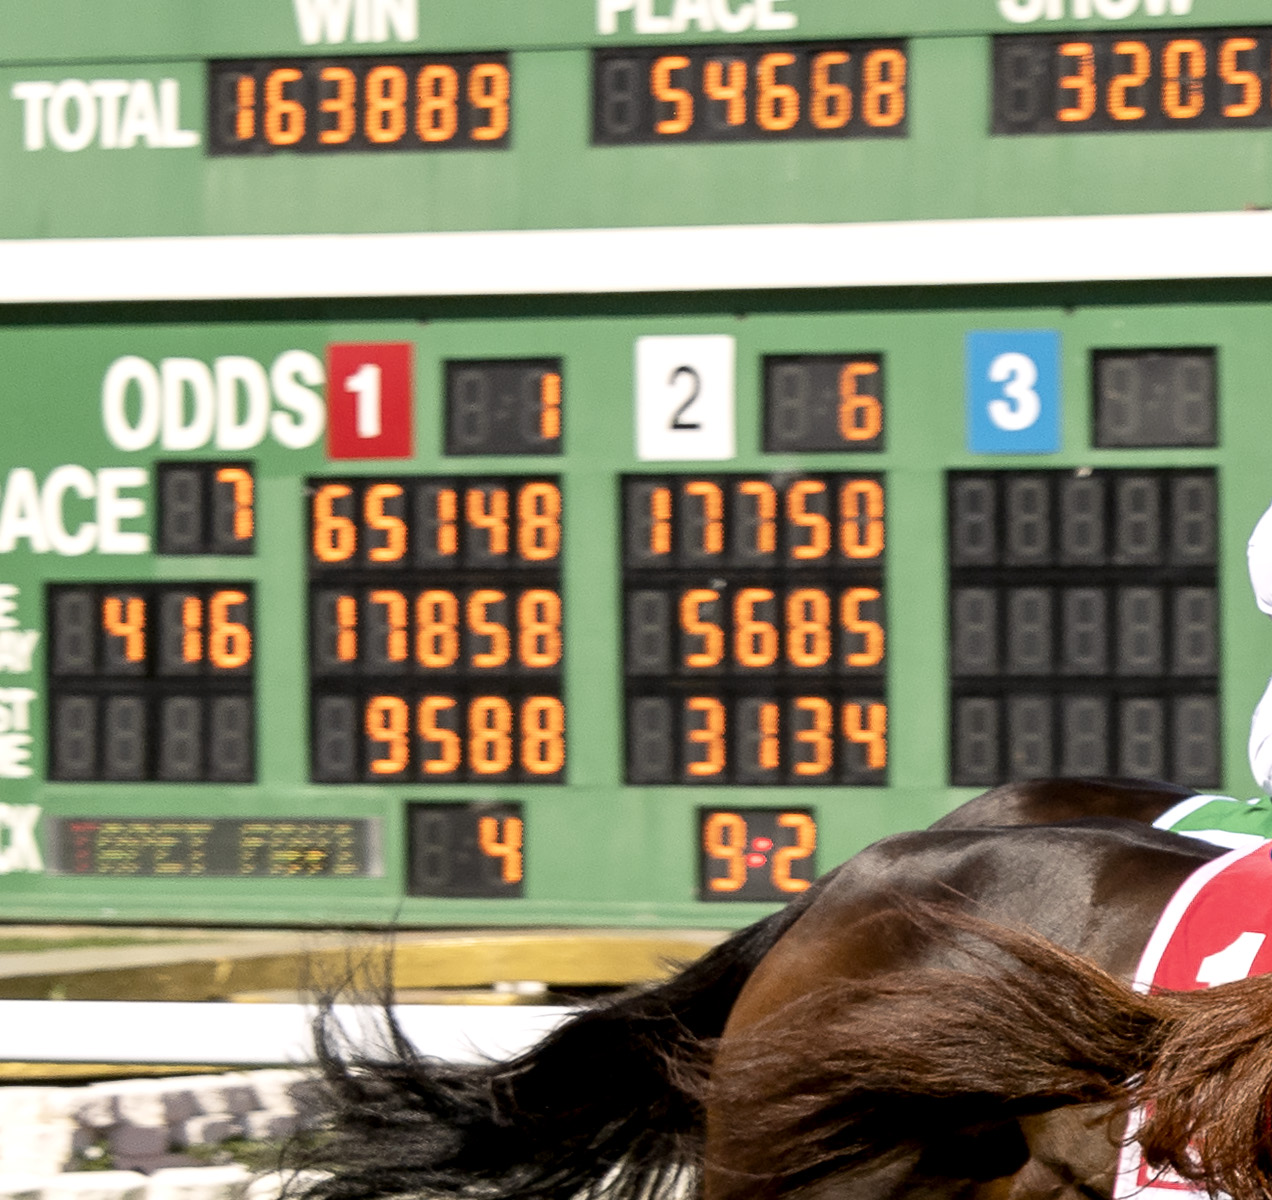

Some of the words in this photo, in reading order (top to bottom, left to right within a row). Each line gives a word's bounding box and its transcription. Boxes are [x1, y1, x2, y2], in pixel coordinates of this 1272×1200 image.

[12, 79, 199, 151] TOTAL
[235, 62, 510, 146] 163889
[650, 49, 907, 135] 54668
[102, 350, 325, 451] ODDS
[346, 364, 382, 438] 1
[668, 365, 702, 431] 2
[838, 362, 882, 441] 6
[987, 352, 1042, 432] 3
[216, 467, 255, 540] 7
[312, 482, 562, 562] 65148
[650, 480, 885, 560] 17750
[103, 590, 252, 669] 416
[336, 589, 562, 669] 17858
[680, 587, 884, 668] 5685
[365, 695, 566, 775] 9588
[687, 696, 888, 776] 3134
[477, 815, 524, 884] 4
